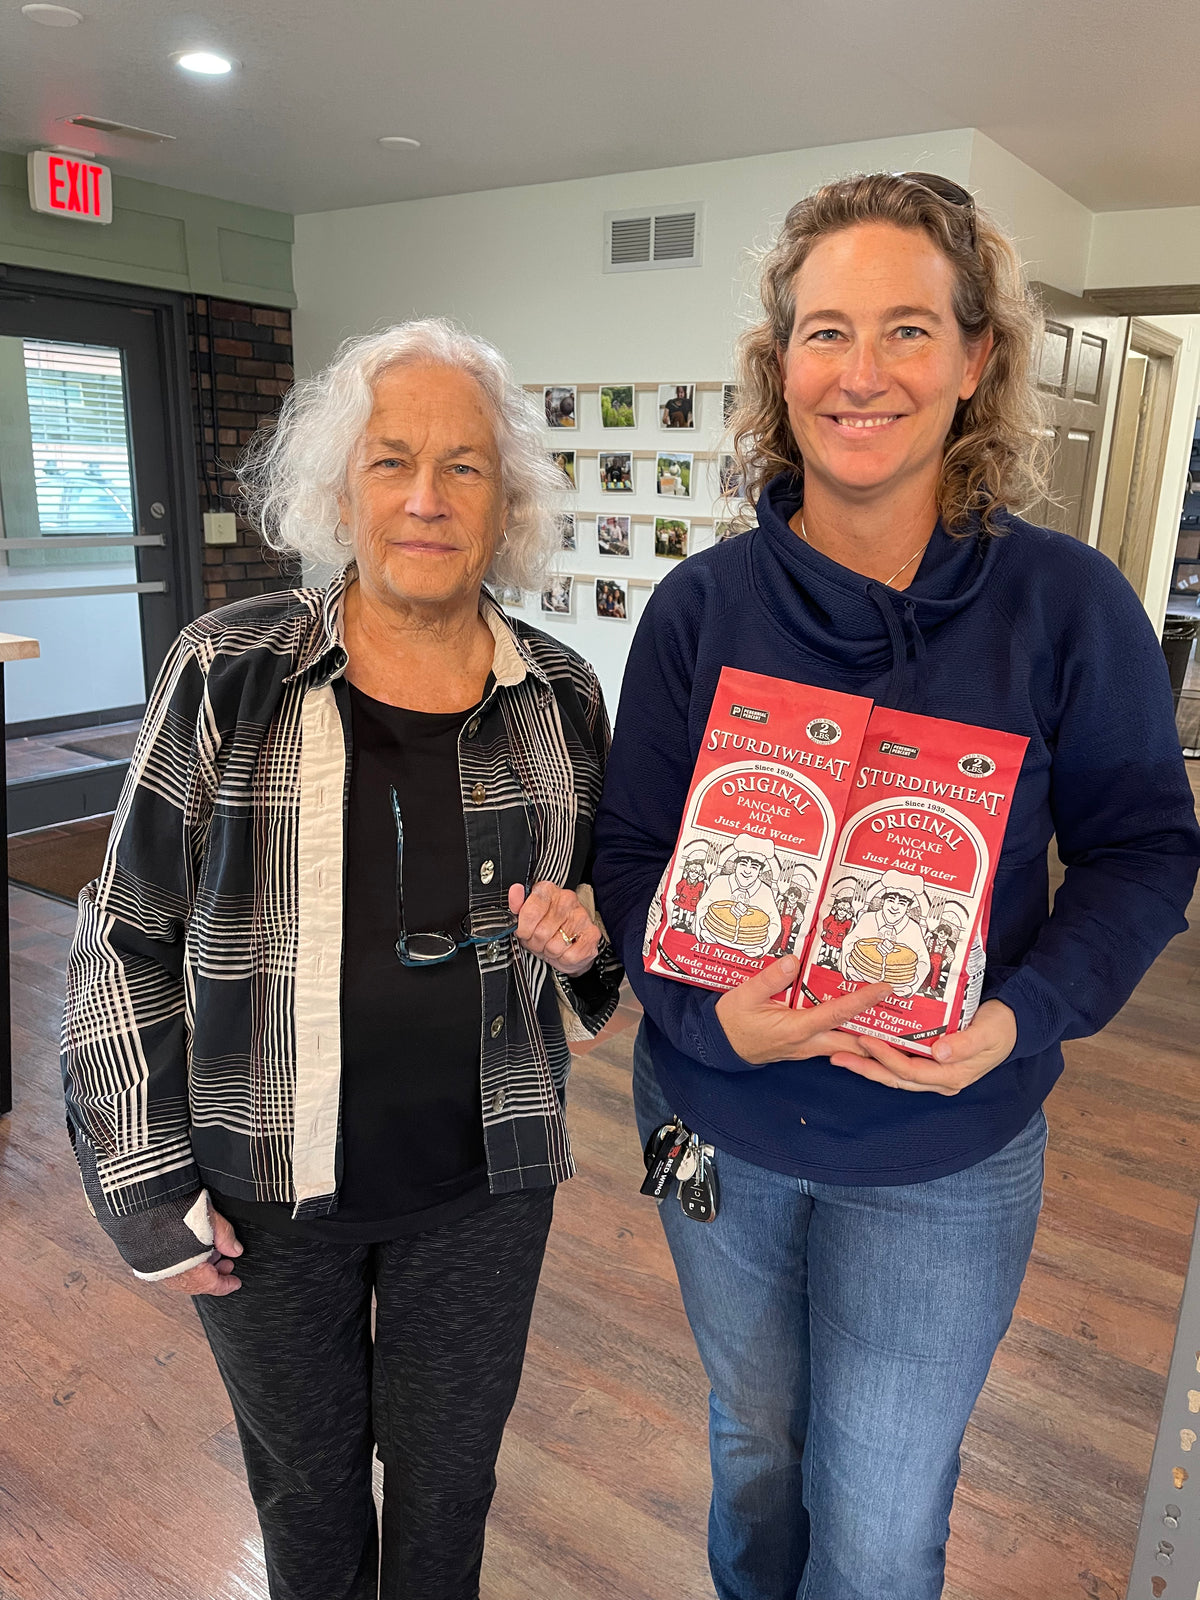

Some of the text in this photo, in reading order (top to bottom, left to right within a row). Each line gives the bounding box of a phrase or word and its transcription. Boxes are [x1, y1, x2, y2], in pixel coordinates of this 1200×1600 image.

[48, 156, 103, 217] EXIT
[819, 723, 830, 734] 2
[707, 729, 851, 782] STURDIWHEAT
[971, 758, 983, 768] 2
[754, 764, 794, 779] Since 1939
[721, 776, 811, 815] ORIGINAL
[856, 767, 1005, 816] STURDIWHEAT
[736, 796, 791, 818] PANCAKE
[748, 810, 774, 825] MIX
[904, 800, 946, 814] Since 1939
[714, 816, 806, 845] Just Add Water
[871, 813, 964, 851] ORIGINAL
[886, 832, 943, 854] PANCAKE
[898, 847, 924, 861] MIX
[862, 851, 957, 882] Just Add Water
[666, 960, 680, 972] FREE
[675, 954, 703, 968] Made
[705, 964, 728, 976] with
[690, 942, 711, 955] All
[712, 948, 764, 970] Natural
[690, 967, 723, 981] Wheat
[836, 981, 858, 993] All
[883, 996, 914, 1011] ural
[853, 1014, 904, 1034] eat Flour
[858, 1026, 868, 1034] OZ
[879, 1011, 923, 1030] Organic
[913, 1029, 938, 1040] LOW FAT
[663, 1158, 674, 1174] RED
[654, 1174, 668, 1196] WING
